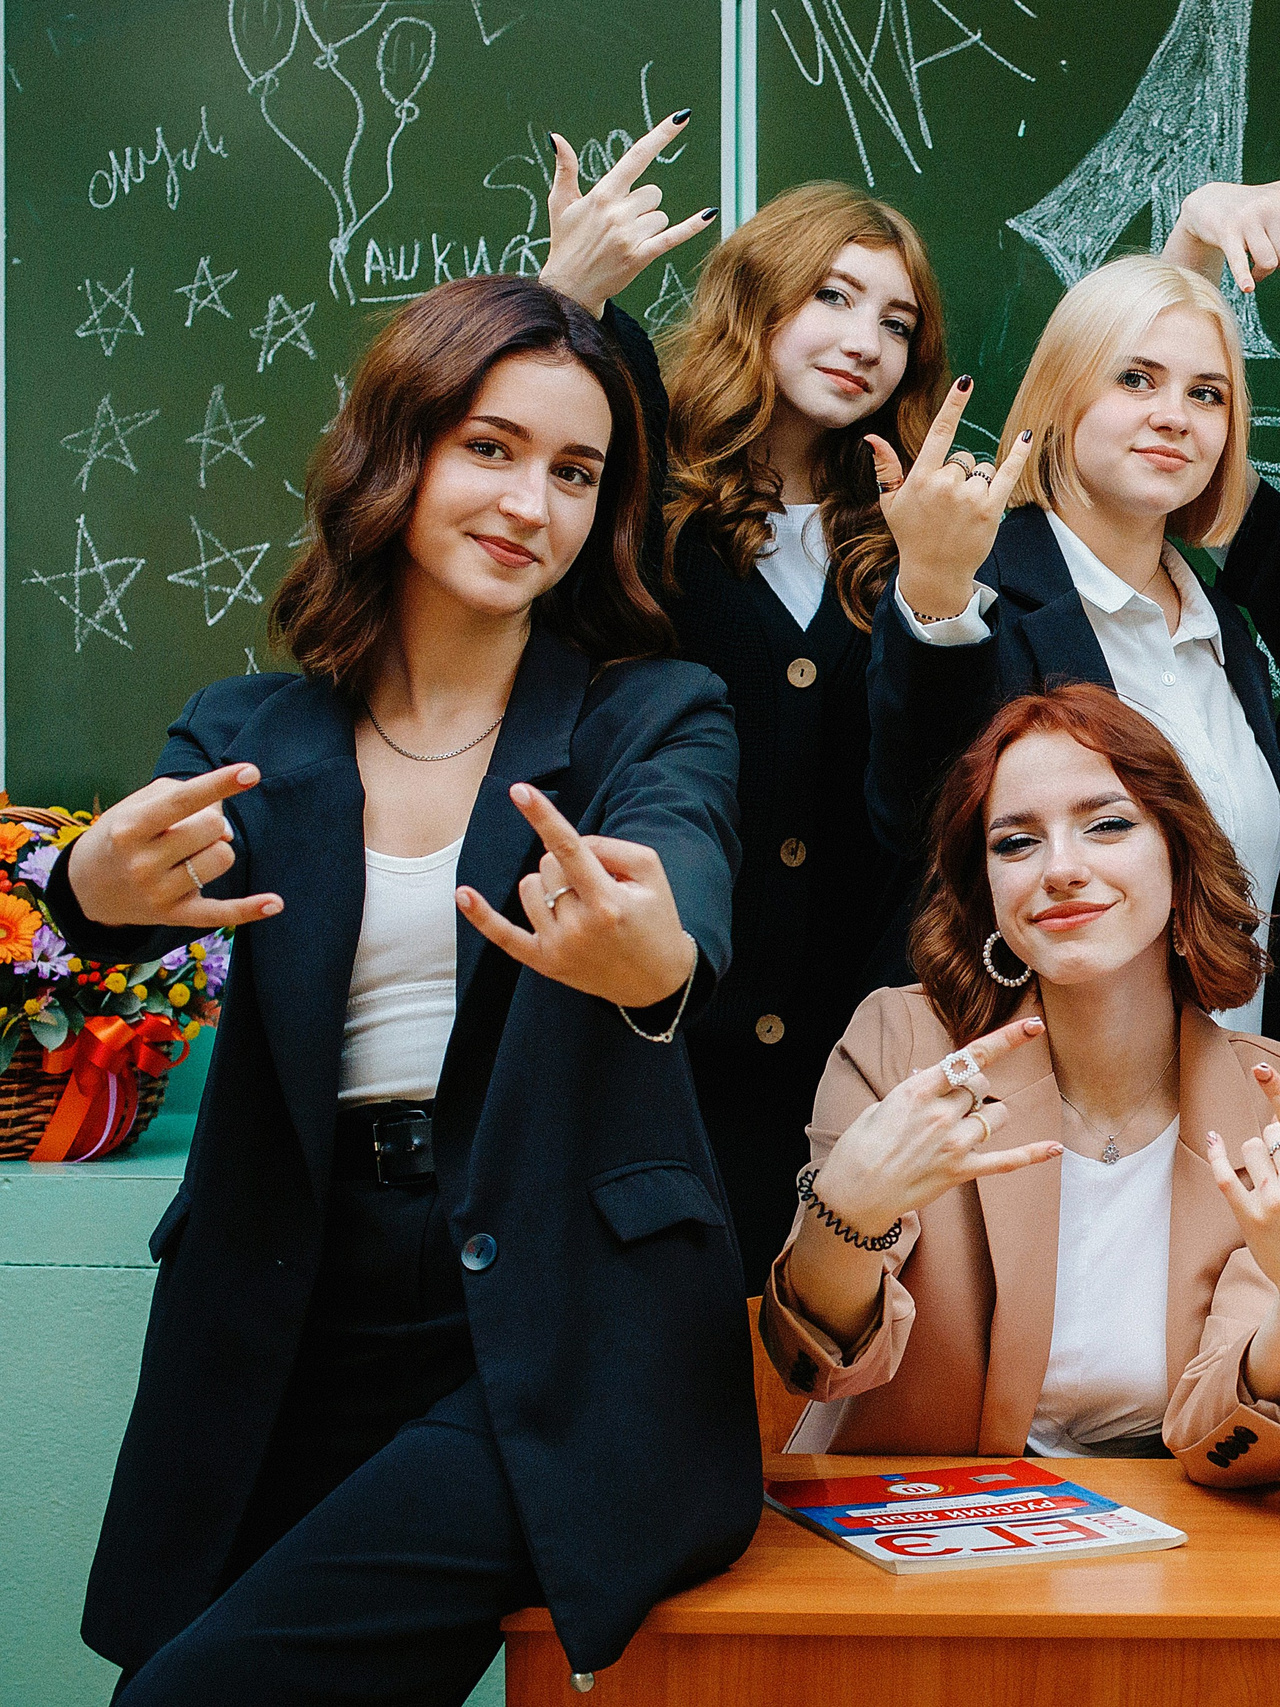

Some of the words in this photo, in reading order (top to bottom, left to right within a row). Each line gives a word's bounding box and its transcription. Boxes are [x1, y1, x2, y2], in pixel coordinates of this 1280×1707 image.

[865, 1511, 940, 1526] ЯЗЫК
[945, 1499, 1057, 1520] РУССКИЙ
[874, 1518, 1110, 1558] ЕГЭ
